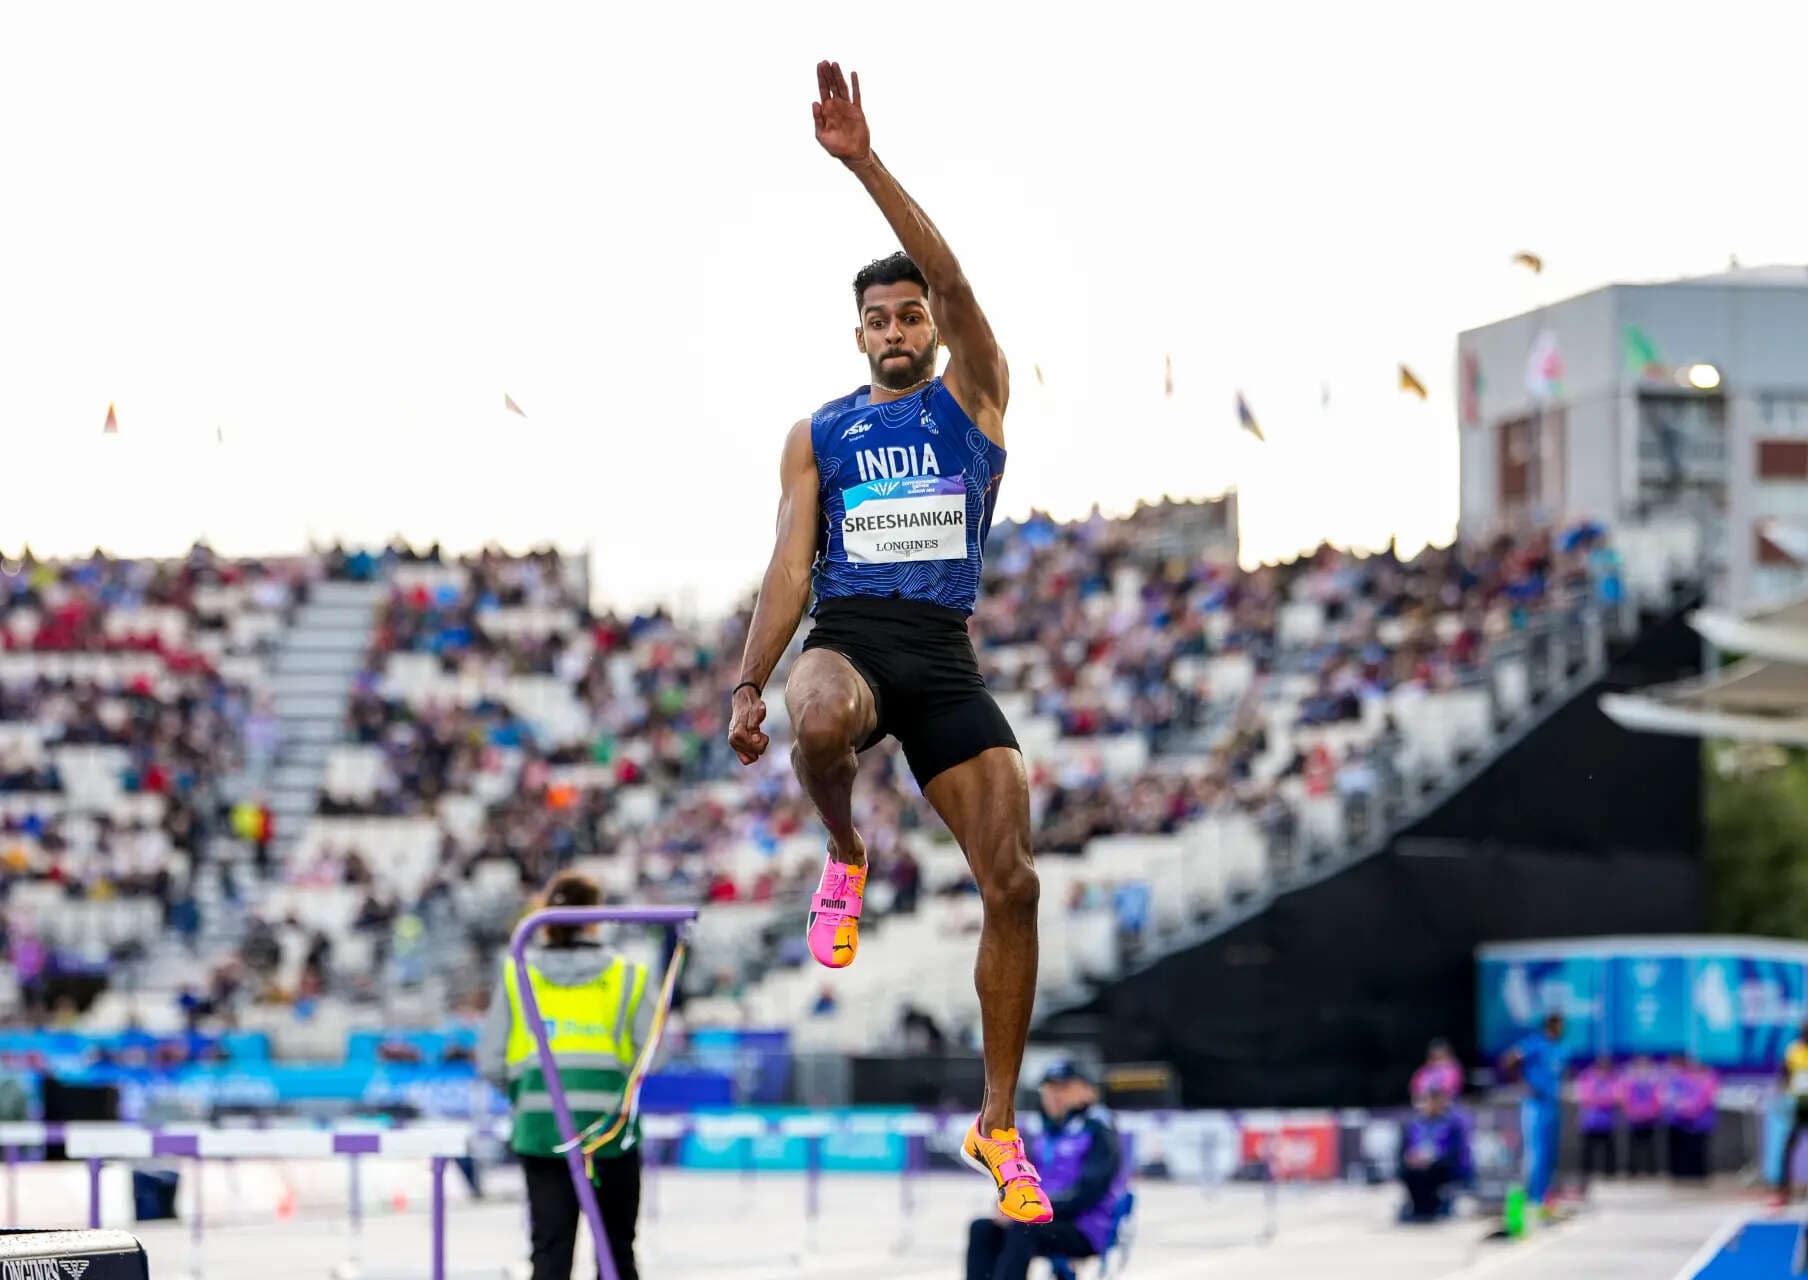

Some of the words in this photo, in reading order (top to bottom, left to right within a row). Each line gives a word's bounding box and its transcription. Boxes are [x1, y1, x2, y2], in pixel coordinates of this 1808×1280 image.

[855, 442, 941, 482] INDIA
[844, 510, 964, 533] SREESHANKAR
[876, 539, 939, 552] LONGINES
[820, 898, 847, 910] PUMA
[2, 1258, 61, 1280] ONGINES
